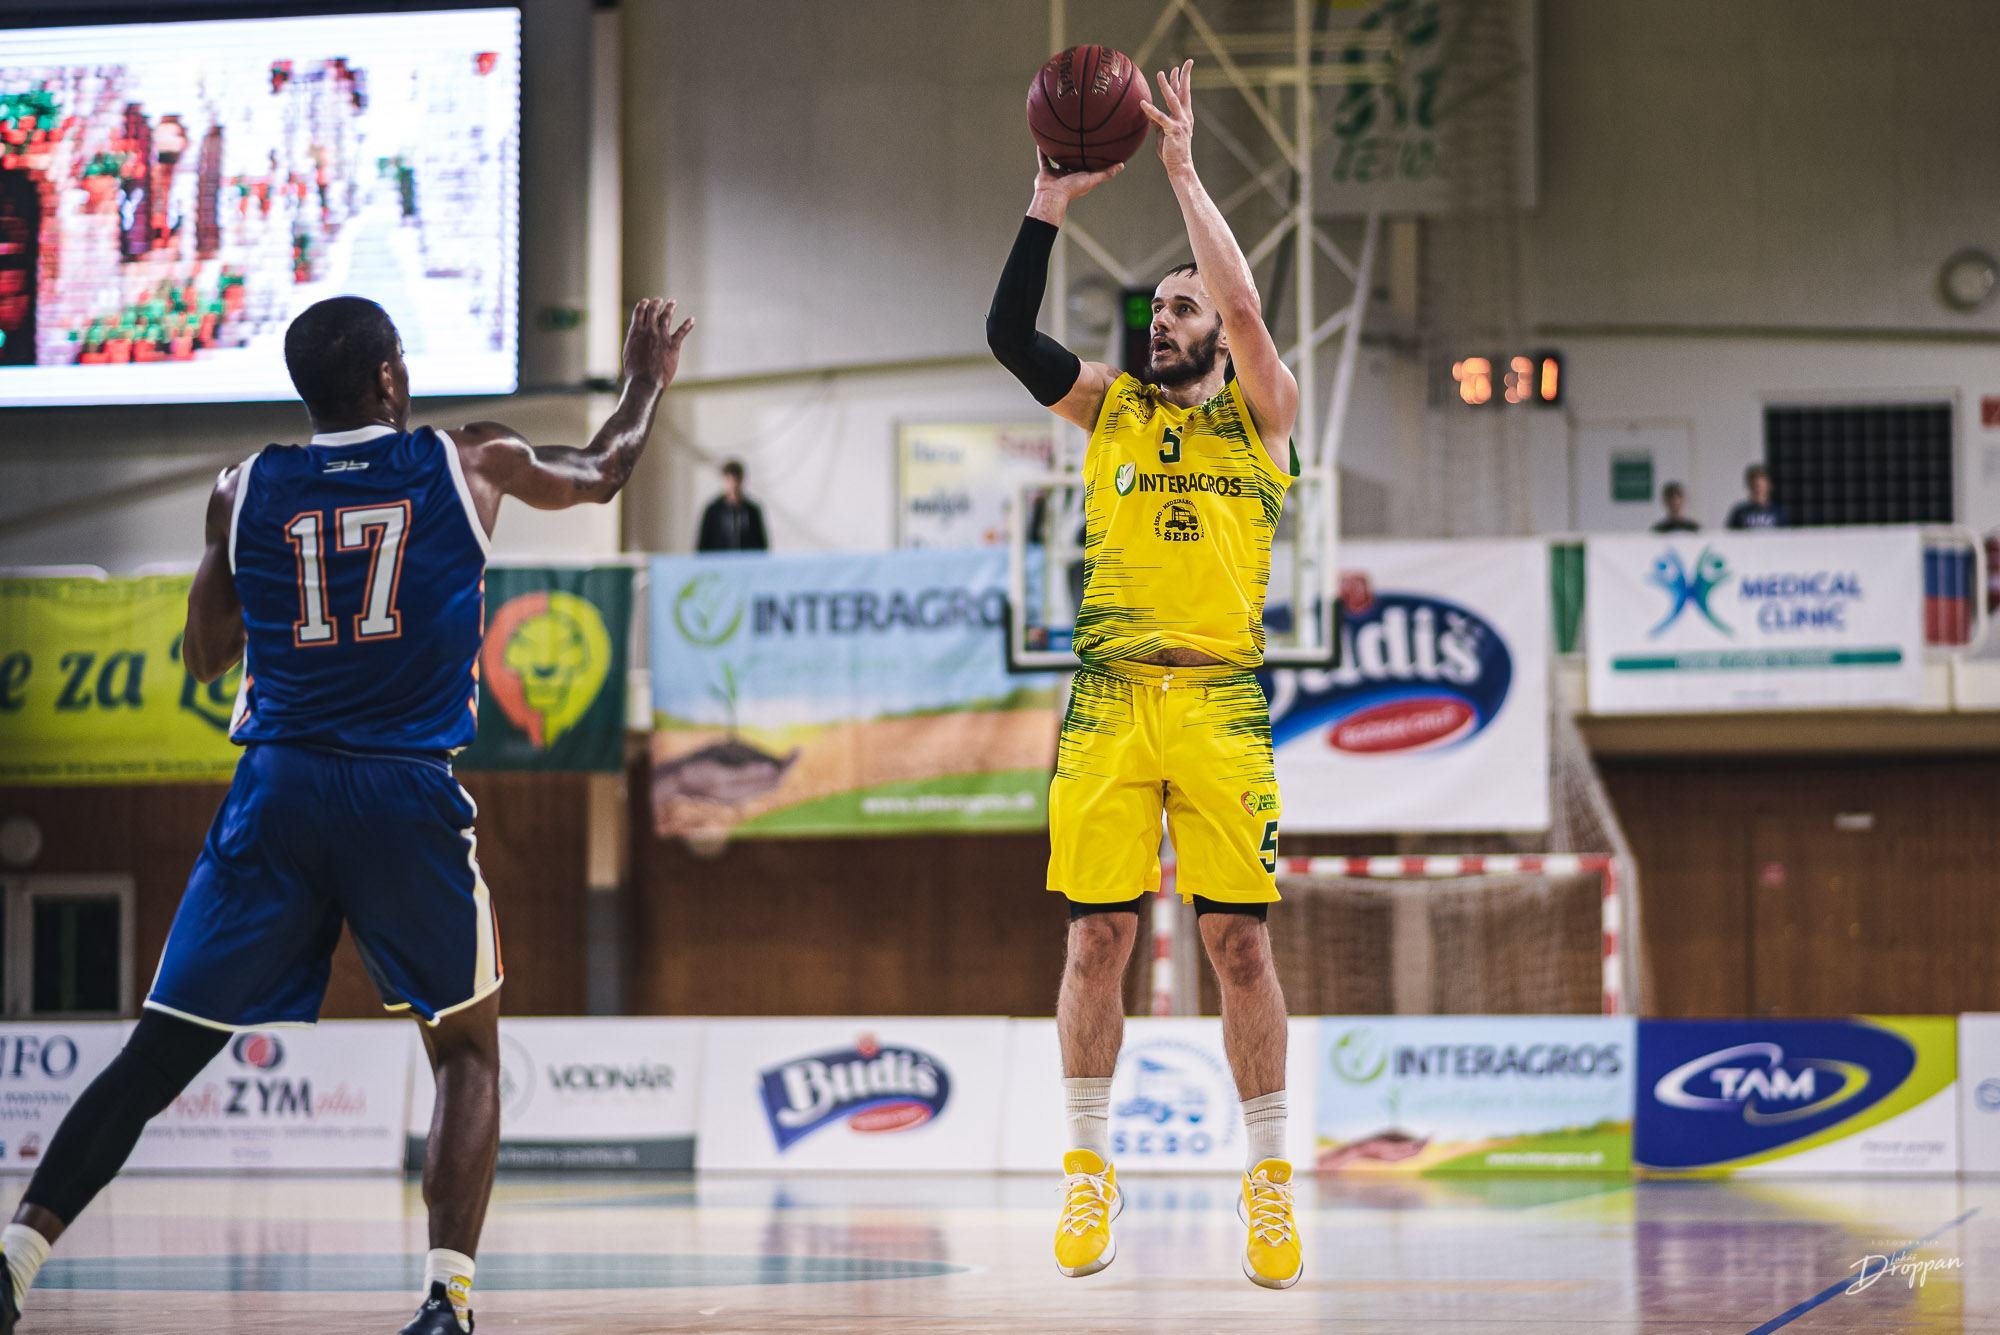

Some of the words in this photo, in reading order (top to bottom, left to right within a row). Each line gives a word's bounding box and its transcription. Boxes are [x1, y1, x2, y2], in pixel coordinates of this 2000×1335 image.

[1159, 425, 1184, 464] 5
[1139, 473, 1242, 497] INTERAGROS
[1164, 529, 1200, 542] ŠEBO
[284, 499, 412, 648] 17
[1740, 571, 1861, 599] MEDICAL
[1757, 603, 1845, 631] CLINIC
[56, 648, 146, 713] za
[1259, 820, 1278, 874] 5
[1394, 1044, 1622, 1076] INTERAGROS
[225, 1078, 313, 1116] ZYM
[1709, 1067, 1815, 1100] TAM
